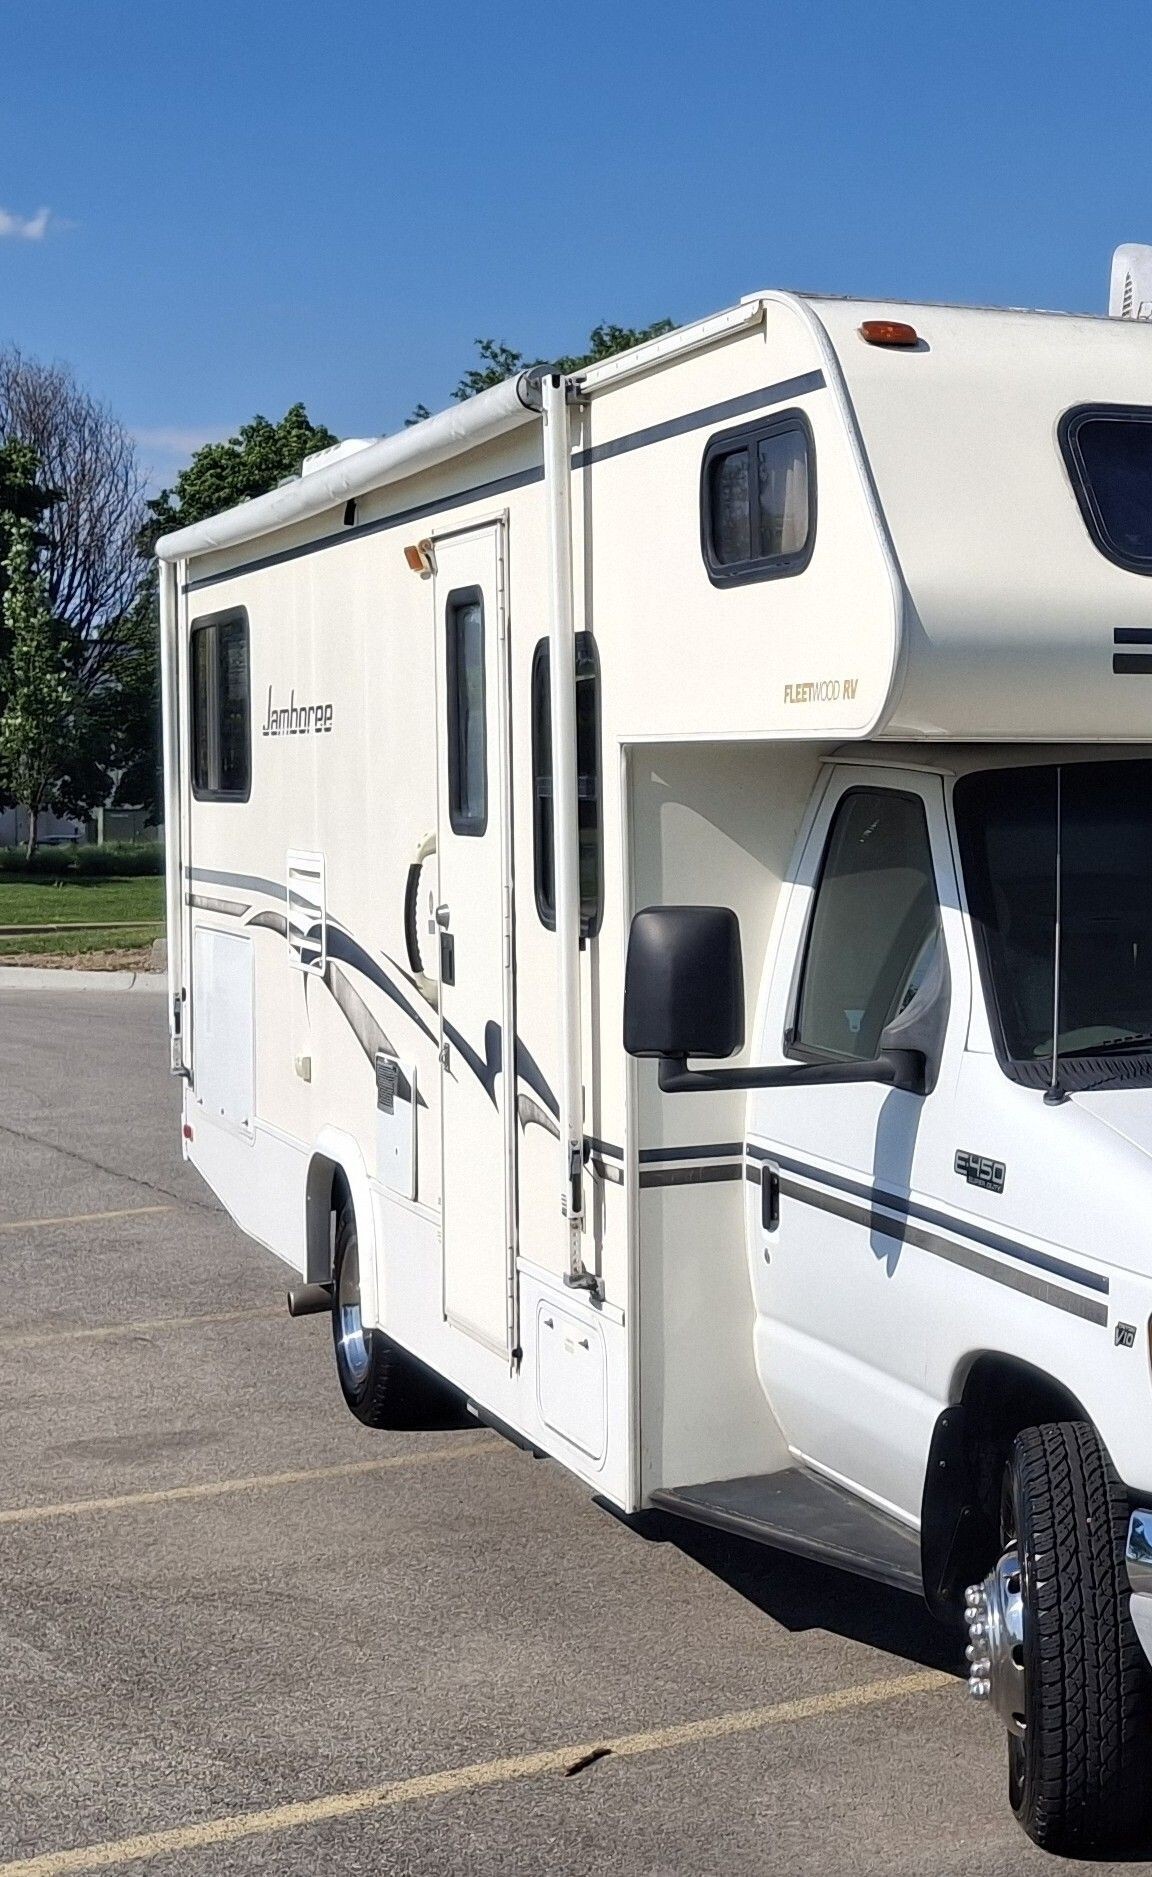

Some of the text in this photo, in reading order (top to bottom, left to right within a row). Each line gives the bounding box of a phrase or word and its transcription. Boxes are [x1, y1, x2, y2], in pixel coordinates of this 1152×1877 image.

[784, 678, 859, 704] FLEETWOOD RV
[262, 684, 333, 736] Jamboree
[1115, 1327, 1134, 1347] V10
